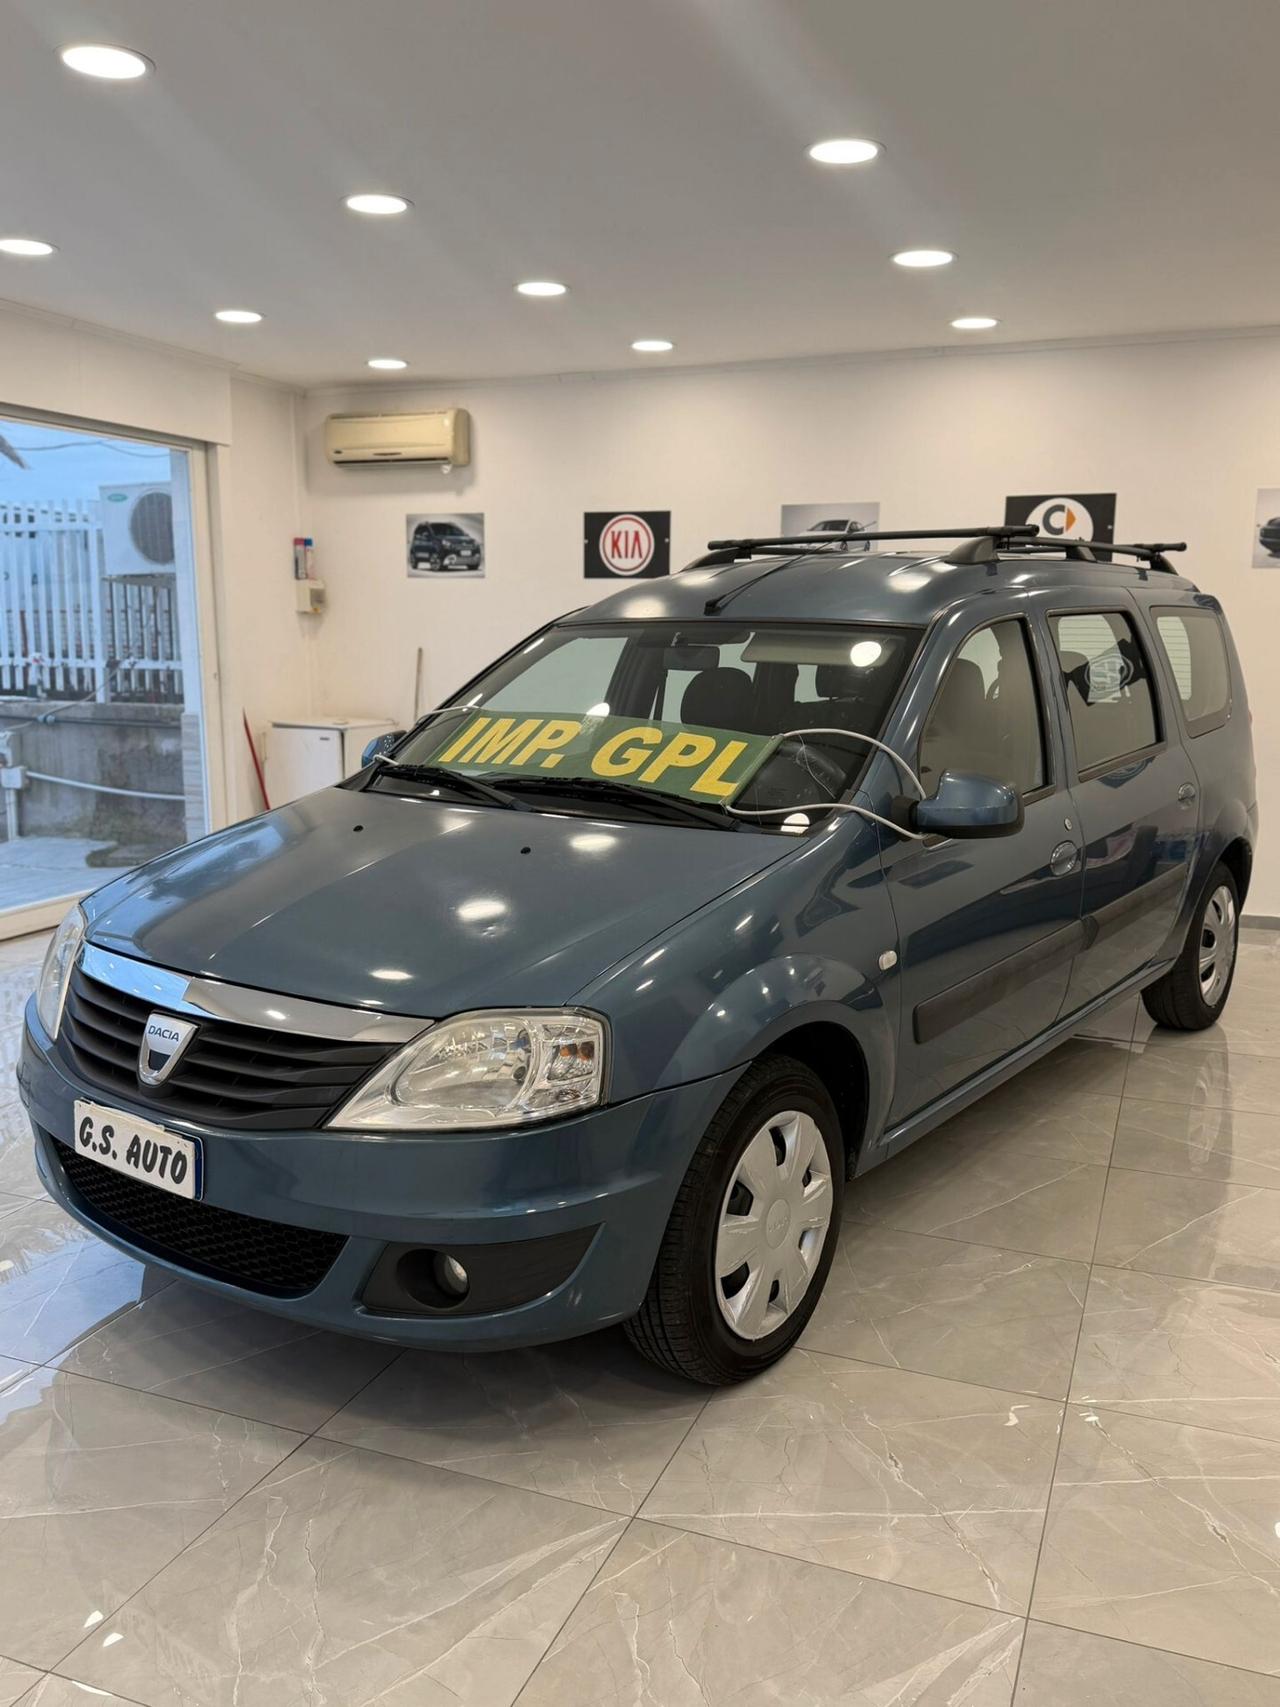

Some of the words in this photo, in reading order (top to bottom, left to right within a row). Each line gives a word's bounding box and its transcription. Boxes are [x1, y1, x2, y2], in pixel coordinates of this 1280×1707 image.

[611, 530, 643, 559] KIA
[438, 717, 582, 769] IMP.
[591, 727, 748, 797] GPL
[148, 1025, 180, 1042] DACIA
[79, 1116, 118, 1160] G.S.
[126, 1134, 188, 1185] AUTO
